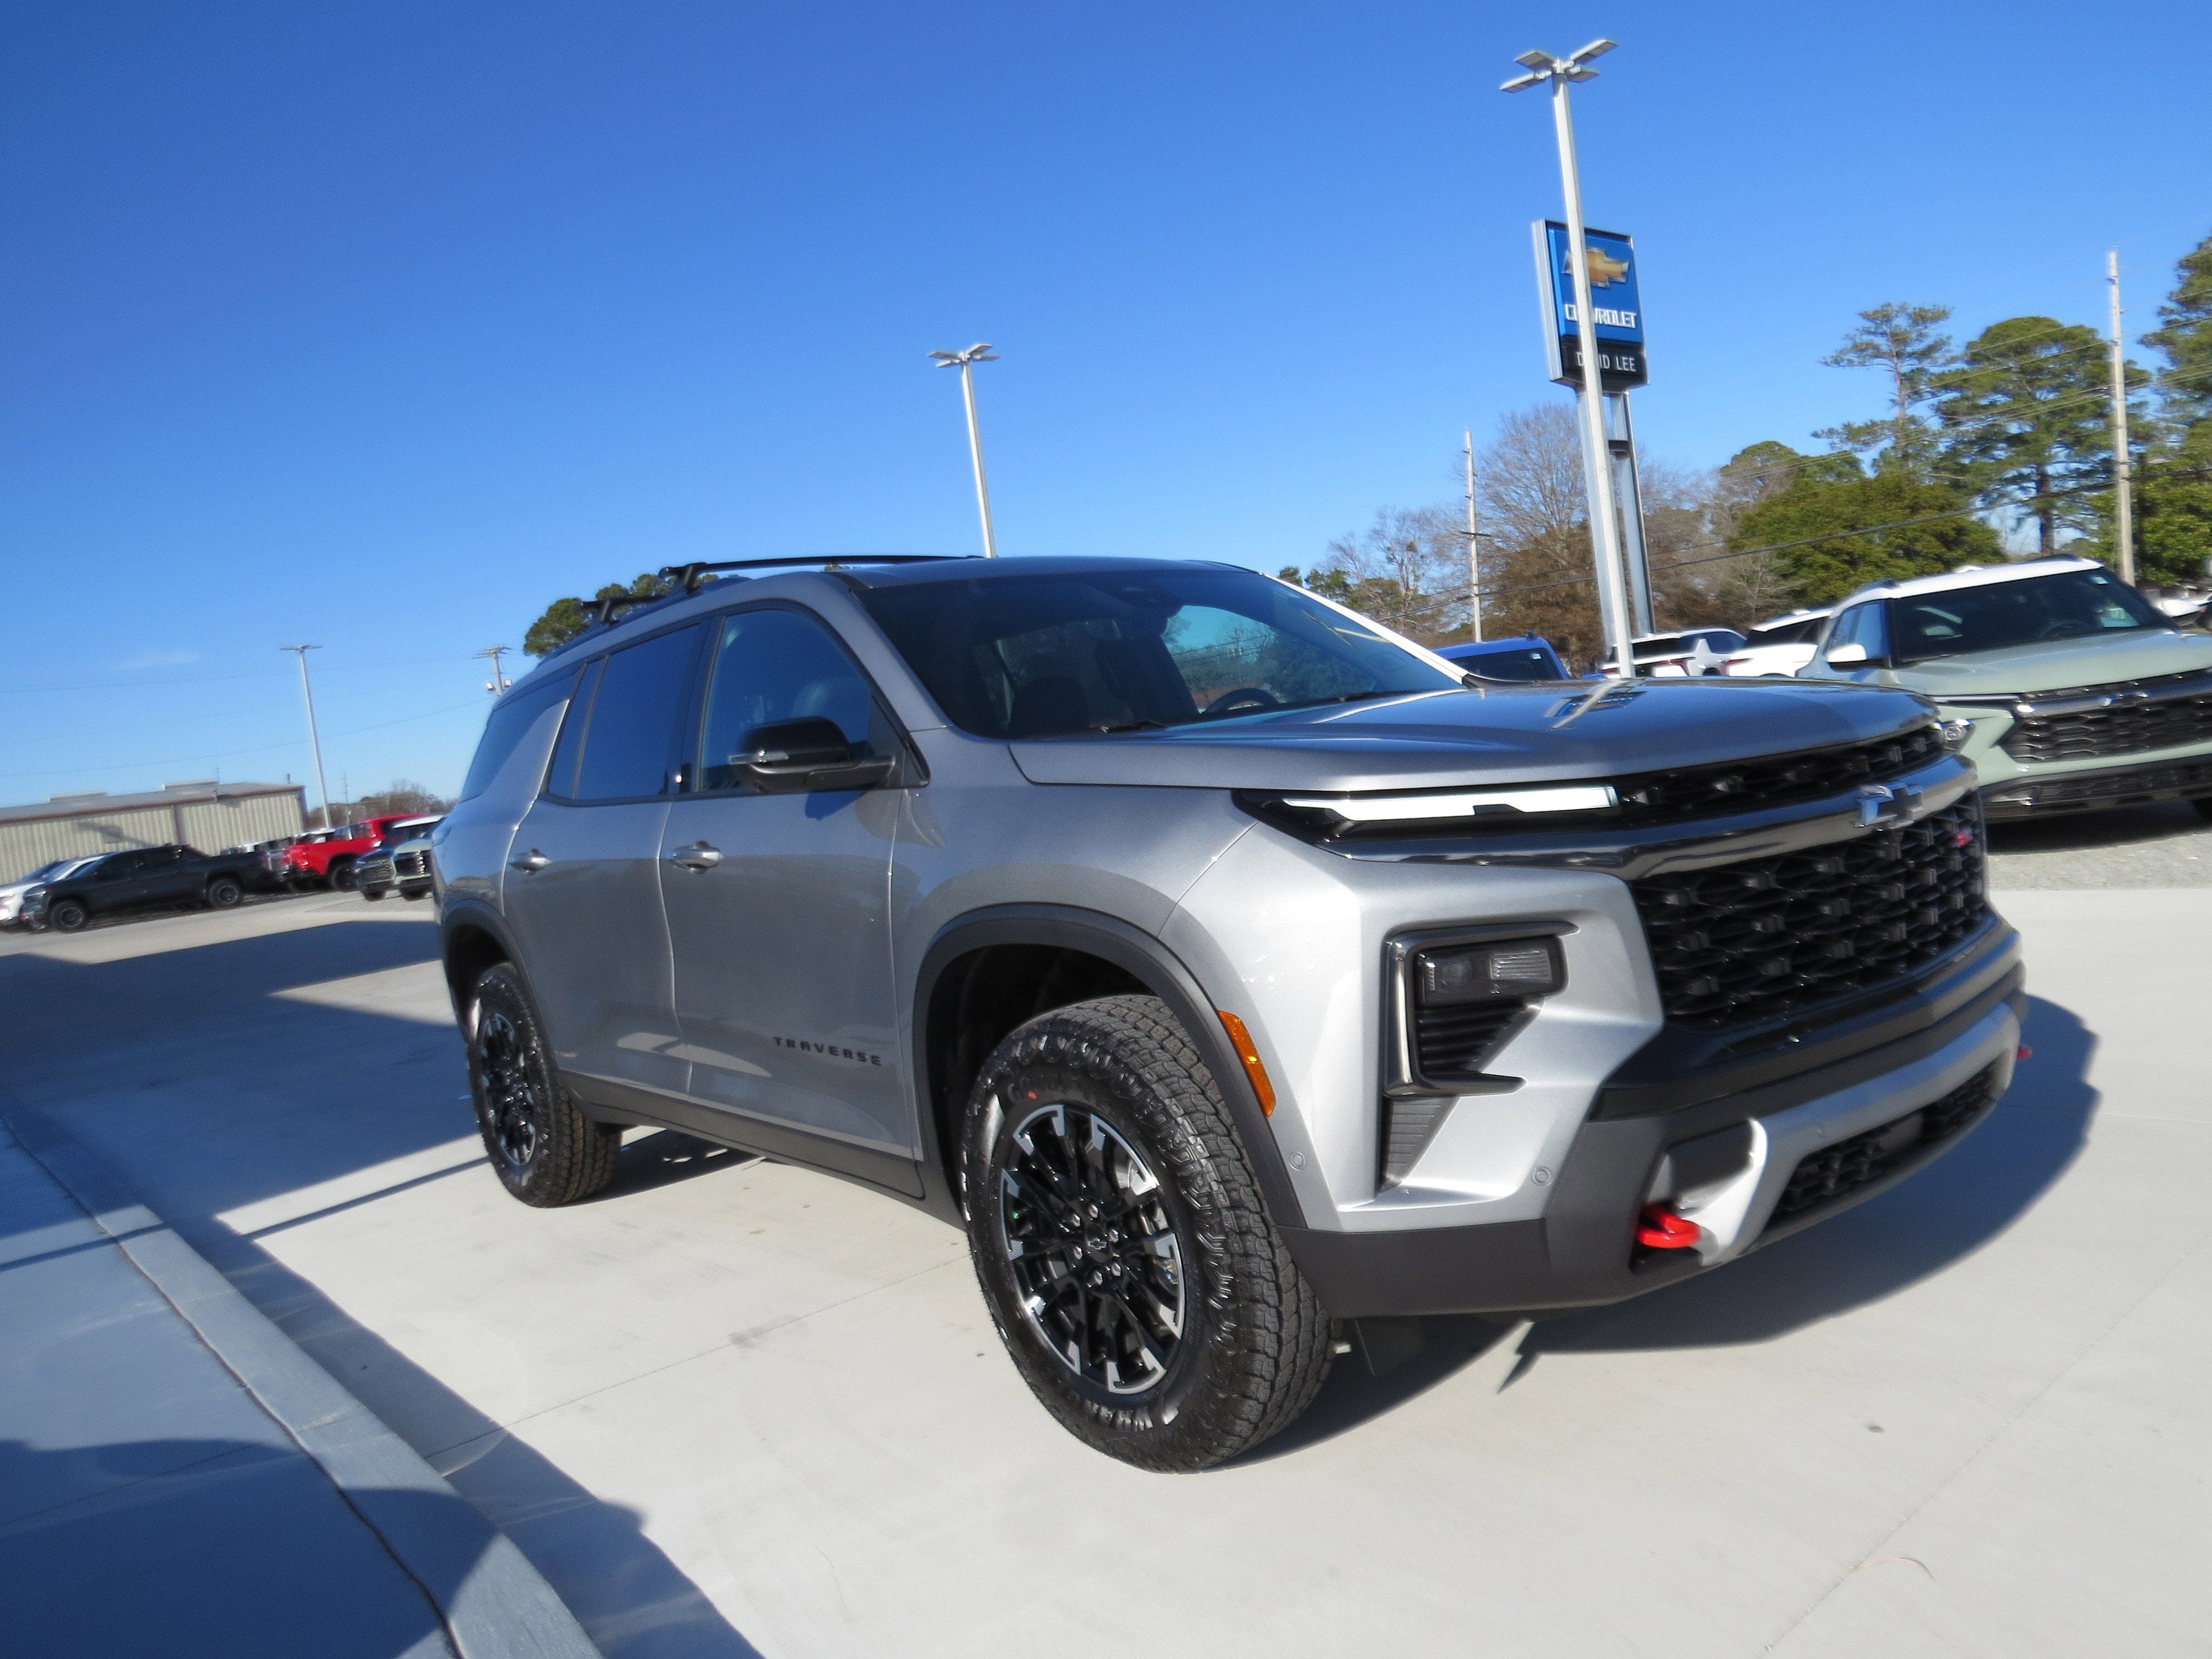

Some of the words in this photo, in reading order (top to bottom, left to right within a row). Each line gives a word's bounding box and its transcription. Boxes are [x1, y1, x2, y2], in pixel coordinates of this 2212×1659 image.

[1576, 352, 1610, 369] DID
[1615, 356, 1636, 372] LEE
[773, 1036, 881, 1067] TRAVERSE
